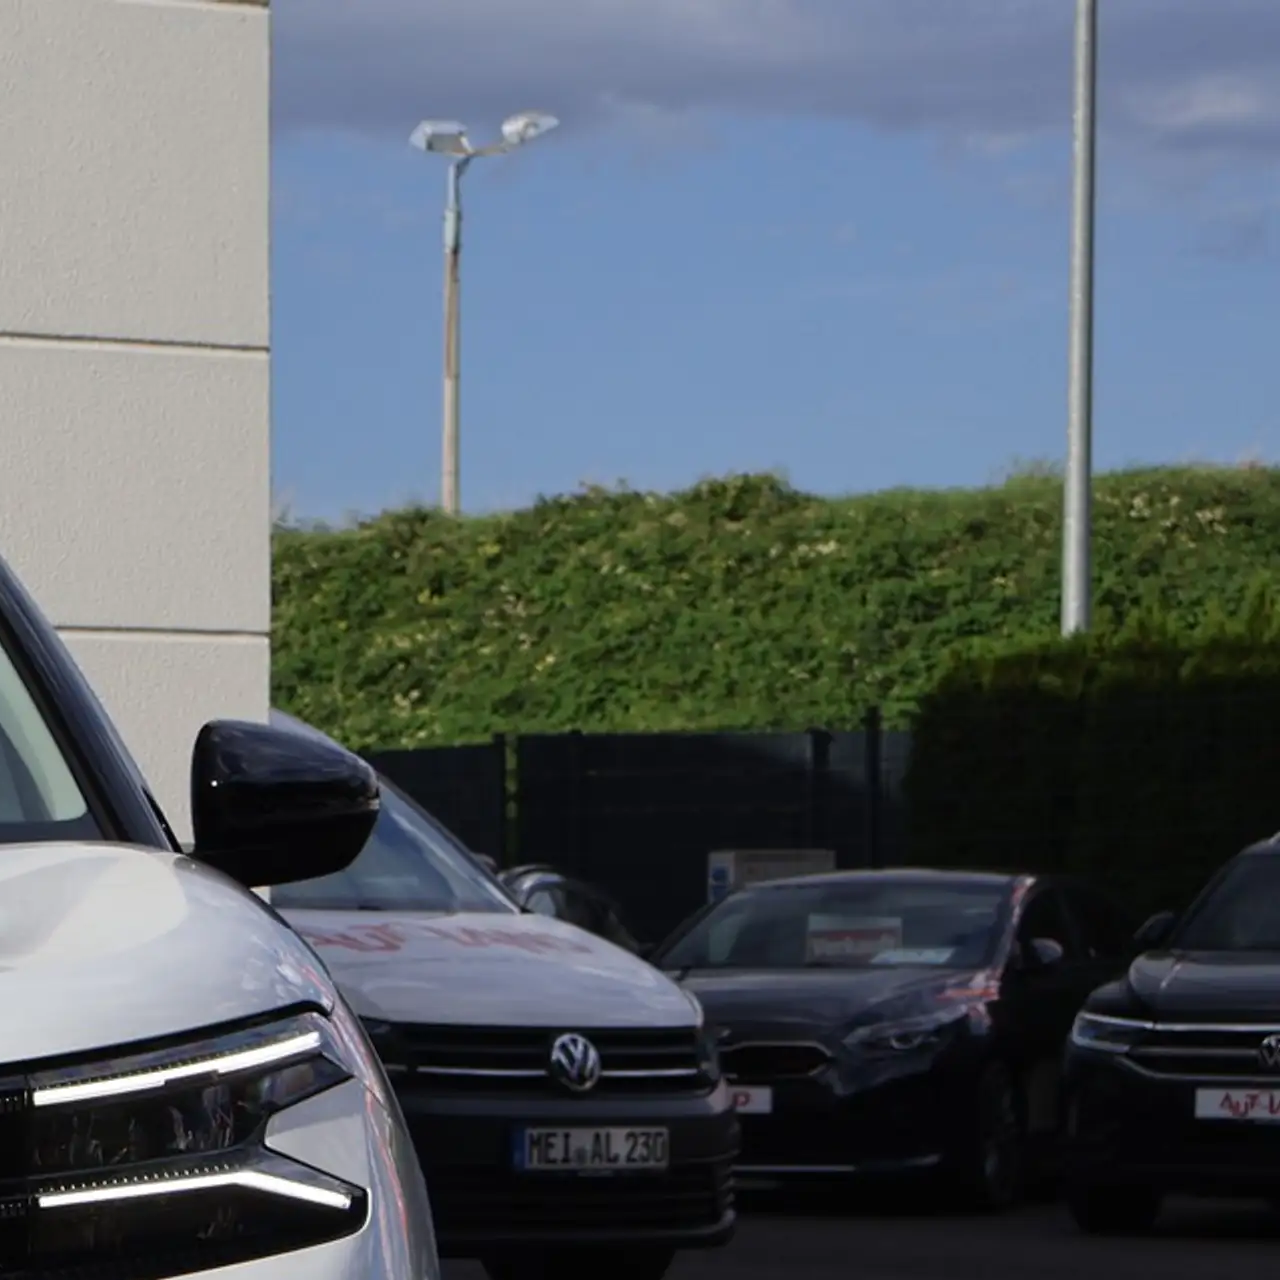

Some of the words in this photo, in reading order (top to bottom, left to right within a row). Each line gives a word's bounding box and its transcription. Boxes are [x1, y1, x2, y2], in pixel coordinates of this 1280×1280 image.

[529, 1132, 571, 1165] MEI
[591, 1131, 620, 1165] AL
[624, 1131, 666, 1164] 230
